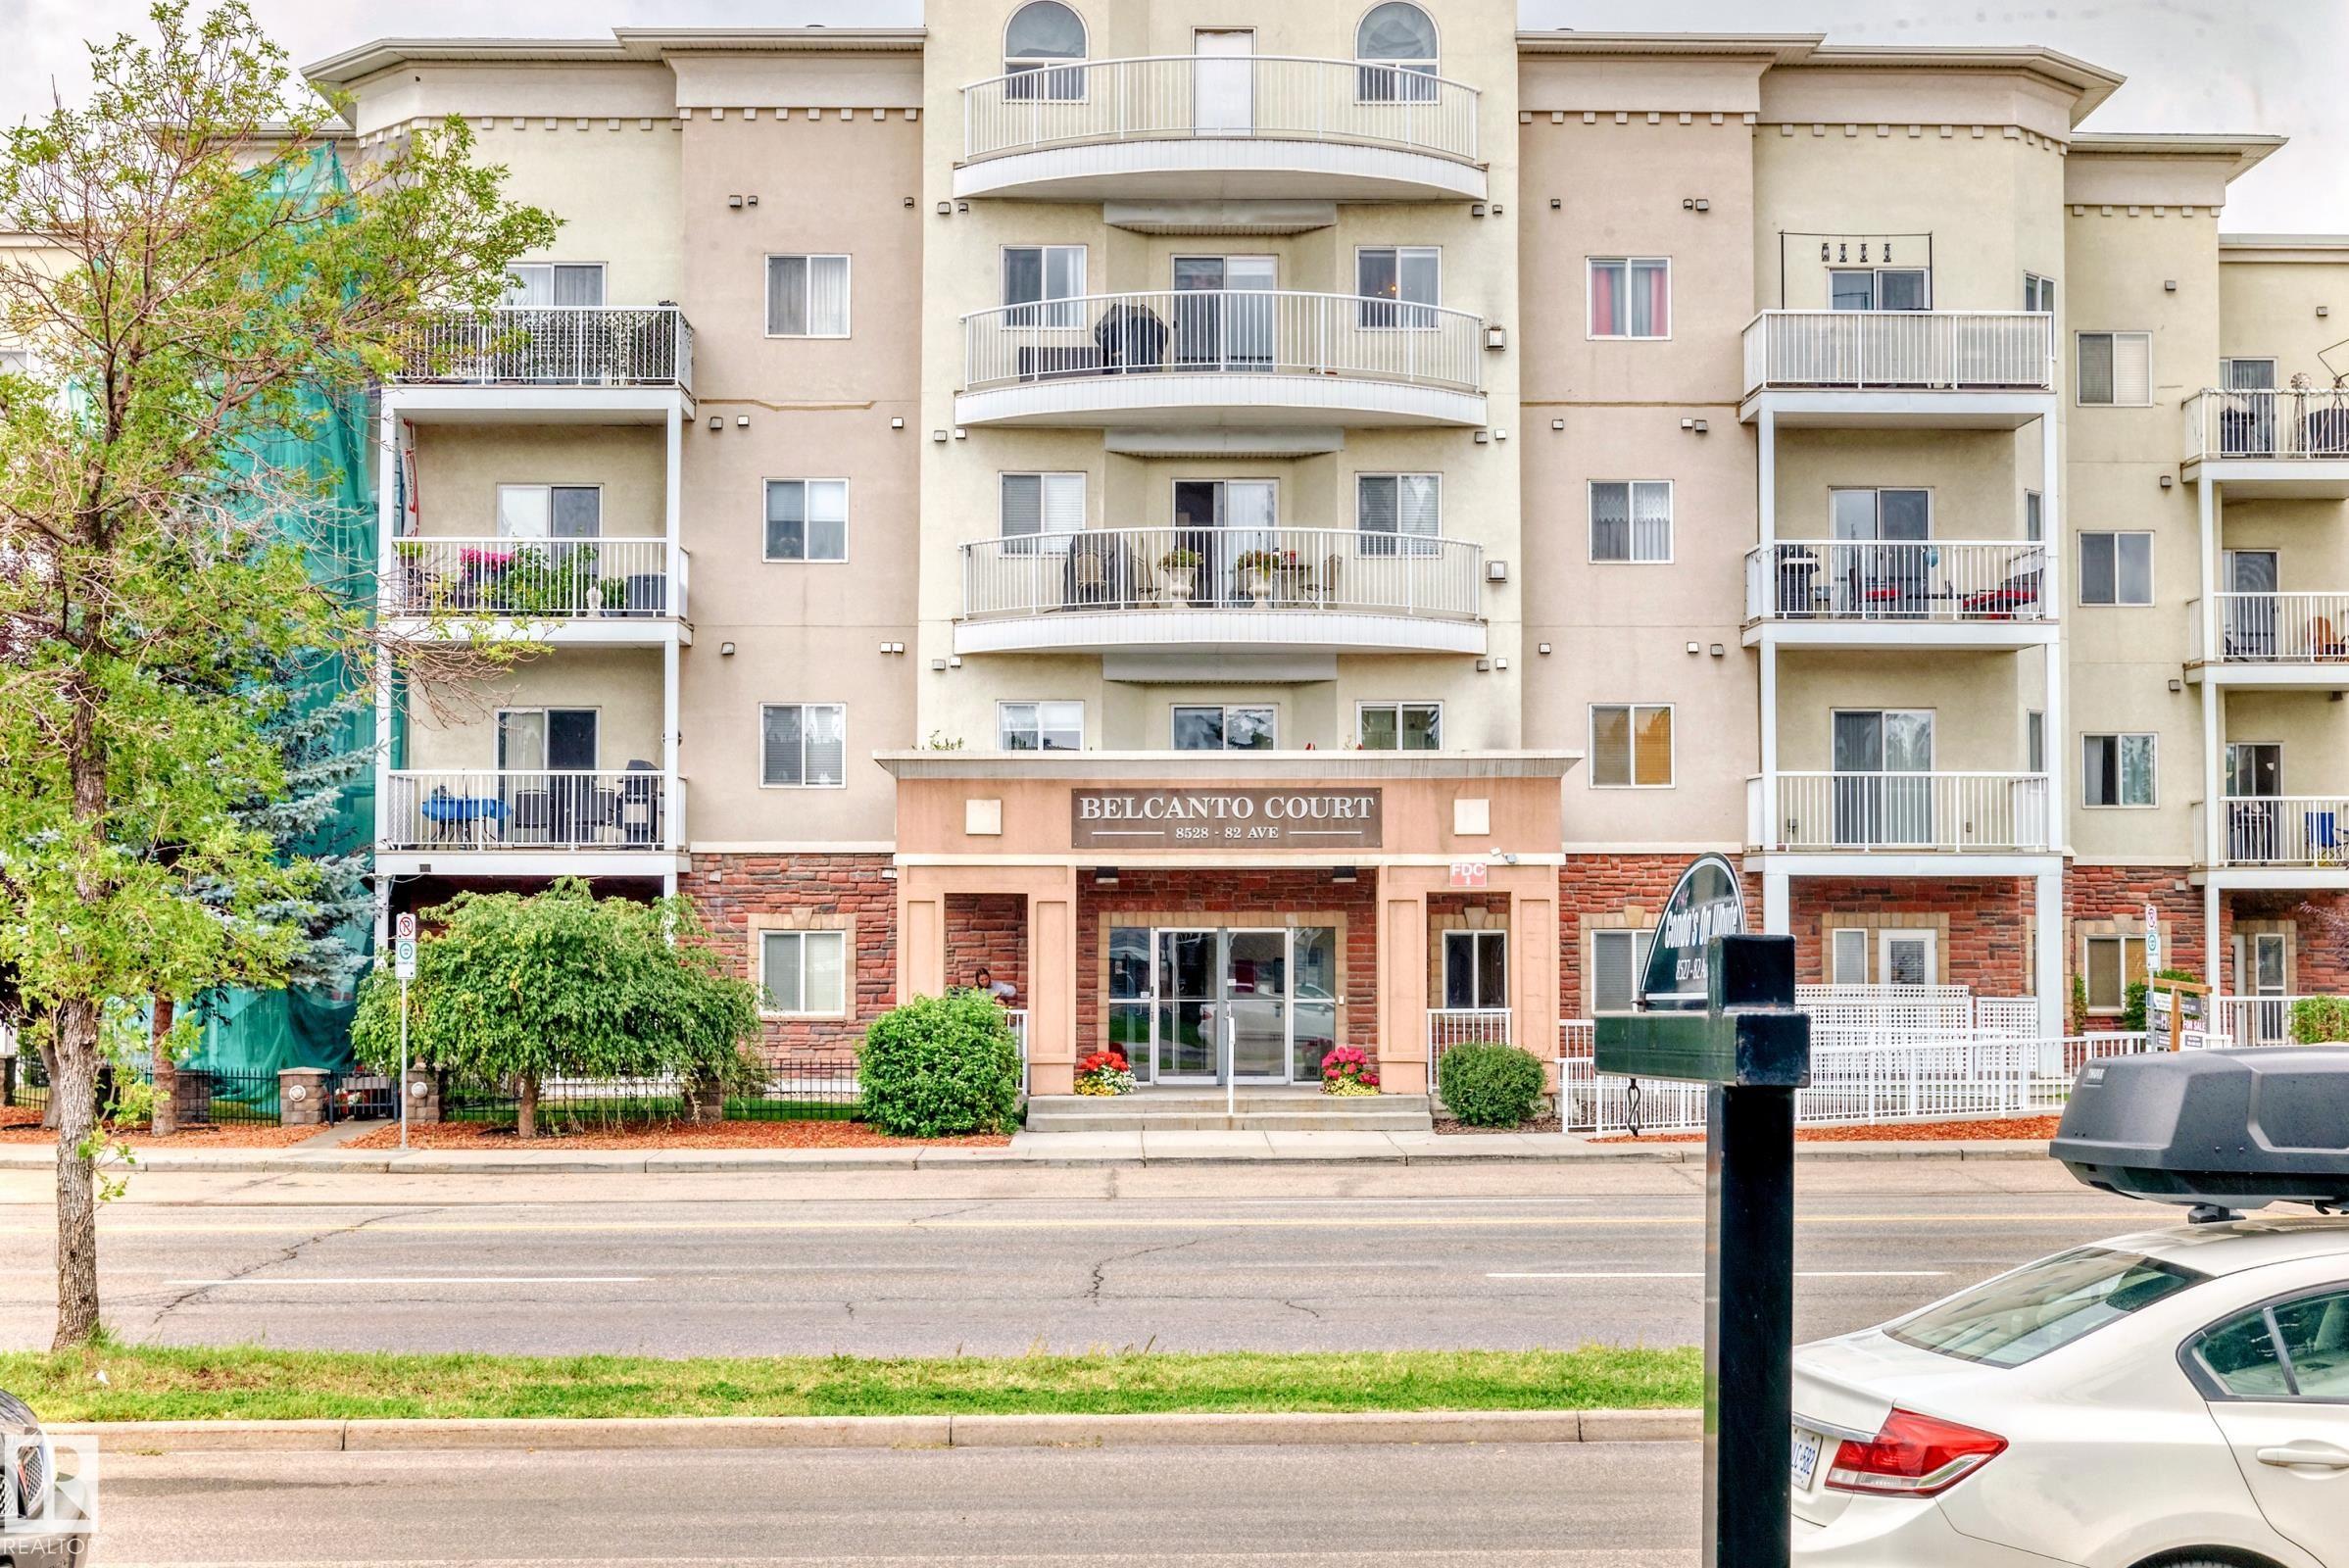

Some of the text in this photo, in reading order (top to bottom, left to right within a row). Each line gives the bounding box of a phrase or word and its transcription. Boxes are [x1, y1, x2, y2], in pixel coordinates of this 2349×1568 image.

[1079, 796, 1375, 819] BELCANTO COURT
[1175, 827, 1209, 839] 8528
[1224, 827, 1242, 839] 82
[1247, 826, 1279, 839] AVE
[1451, 862, 1485, 877] FDC
[1665, 908, 1698, 949] Condo's
[1699, 906, 1711, 945] On
[1676, 958, 1691, 981] 8527
[1692, 957, 1702, 980] 82
[2182, 1019, 2194, 1031] FOR
[2193, 1020, 2207, 1033] SALE
